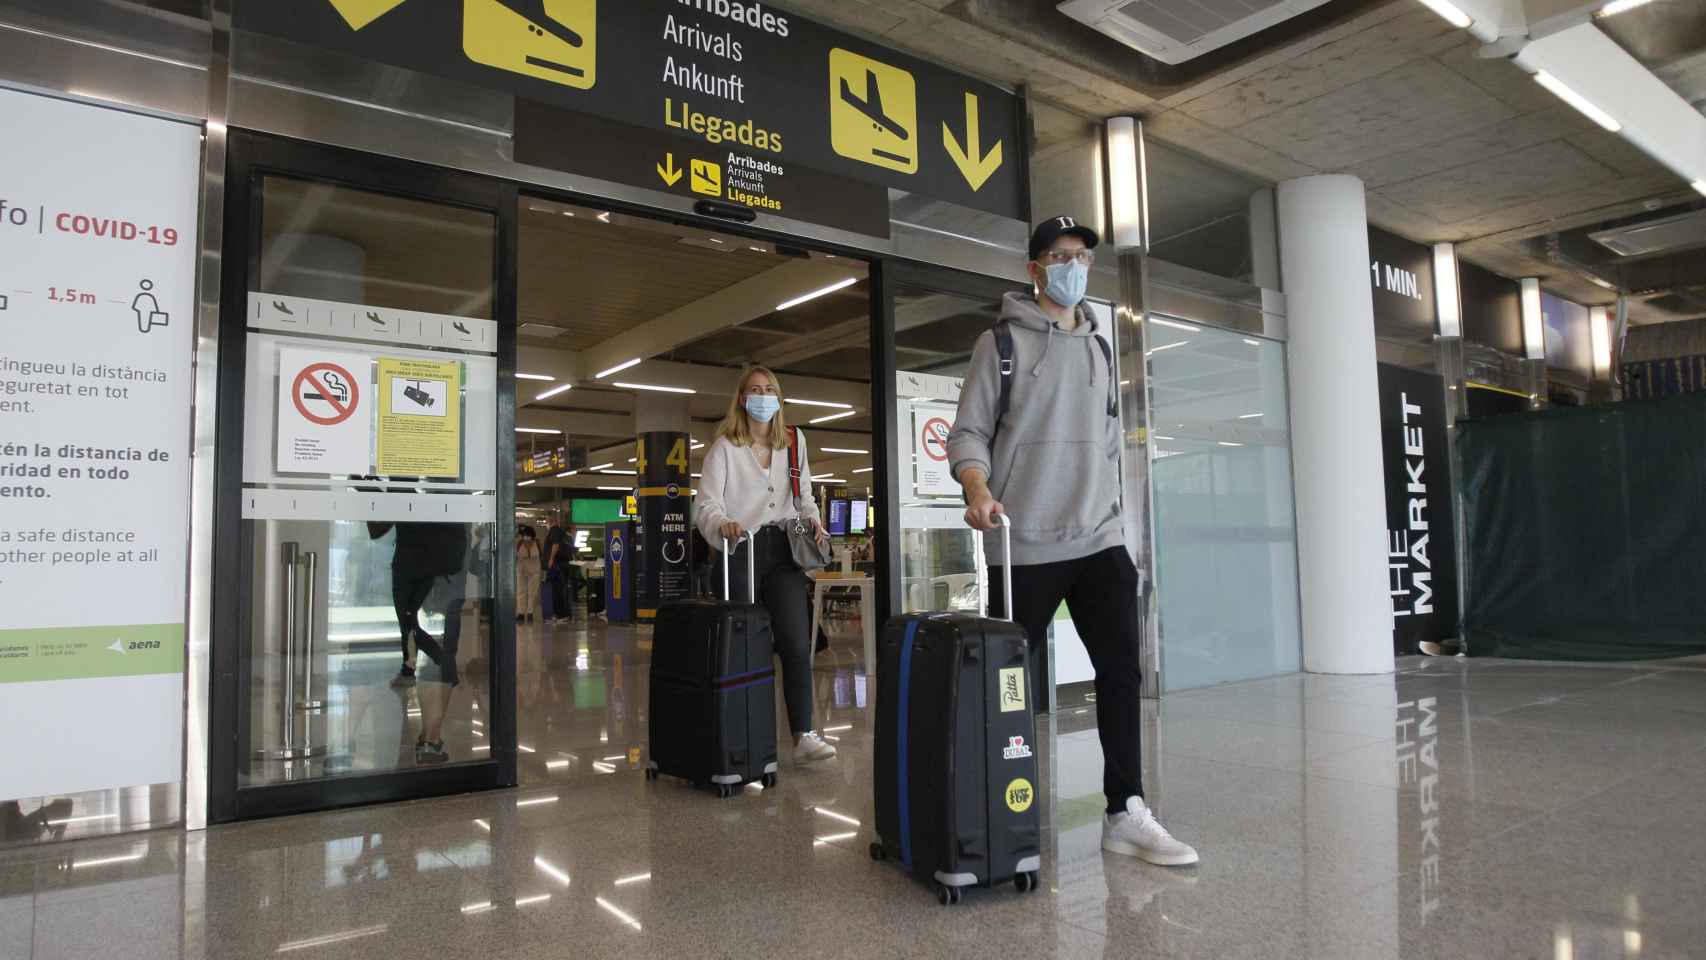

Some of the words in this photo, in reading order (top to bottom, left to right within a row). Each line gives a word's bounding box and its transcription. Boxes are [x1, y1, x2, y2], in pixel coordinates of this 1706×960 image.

[678, 0, 789, 37] bades
[663, 14, 743, 62] Arrivals
[663, 56, 745, 104] Ankunft
[665, 98, 783, 153] Llegadas
[728, 152, 784, 175] Arribades
[728, 165, 763, 181] Arrivals
[728, 176, 765, 193] Ankunft
[728, 187, 782, 209] Llegadas
[55, 213, 178, 246] COVID-19
[1386, 264, 1422, 301] MIN.
[72, 363, 86, 377] la
[92, 365, 166, 382] distància
[78, 386, 98, 397] en
[105, 385, 129, 400] tot
[0, 400, 34, 413] ent.
[35, 443, 51, 458] la
[58, 445, 142, 461] distancia
[148, 449, 169, 462] de
[666, 438, 687, 475] 4
[0, 463, 51, 478] ridad
[58, 467, 81, 479] en
[88, 466, 130, 480] todo
[0, 485, 51, 498] ento.
[1401, 392, 1433, 615] MARKET
[663, 513, 684, 521] ATM
[0, 531, 11, 543] a
[17, 528, 56, 543] safe
[62, 528, 136, 543] distance
[661, 524, 686, 532] HERE
[0, 549, 49, 563] other
[52, 549, 112, 566] people
[117, 550, 134, 562] at
[139, 548, 159, 562] all
[1387, 528, 1411, 630] THE
[128, 639, 161, 651] aena
[1004, 673, 1022, 704] Patta
